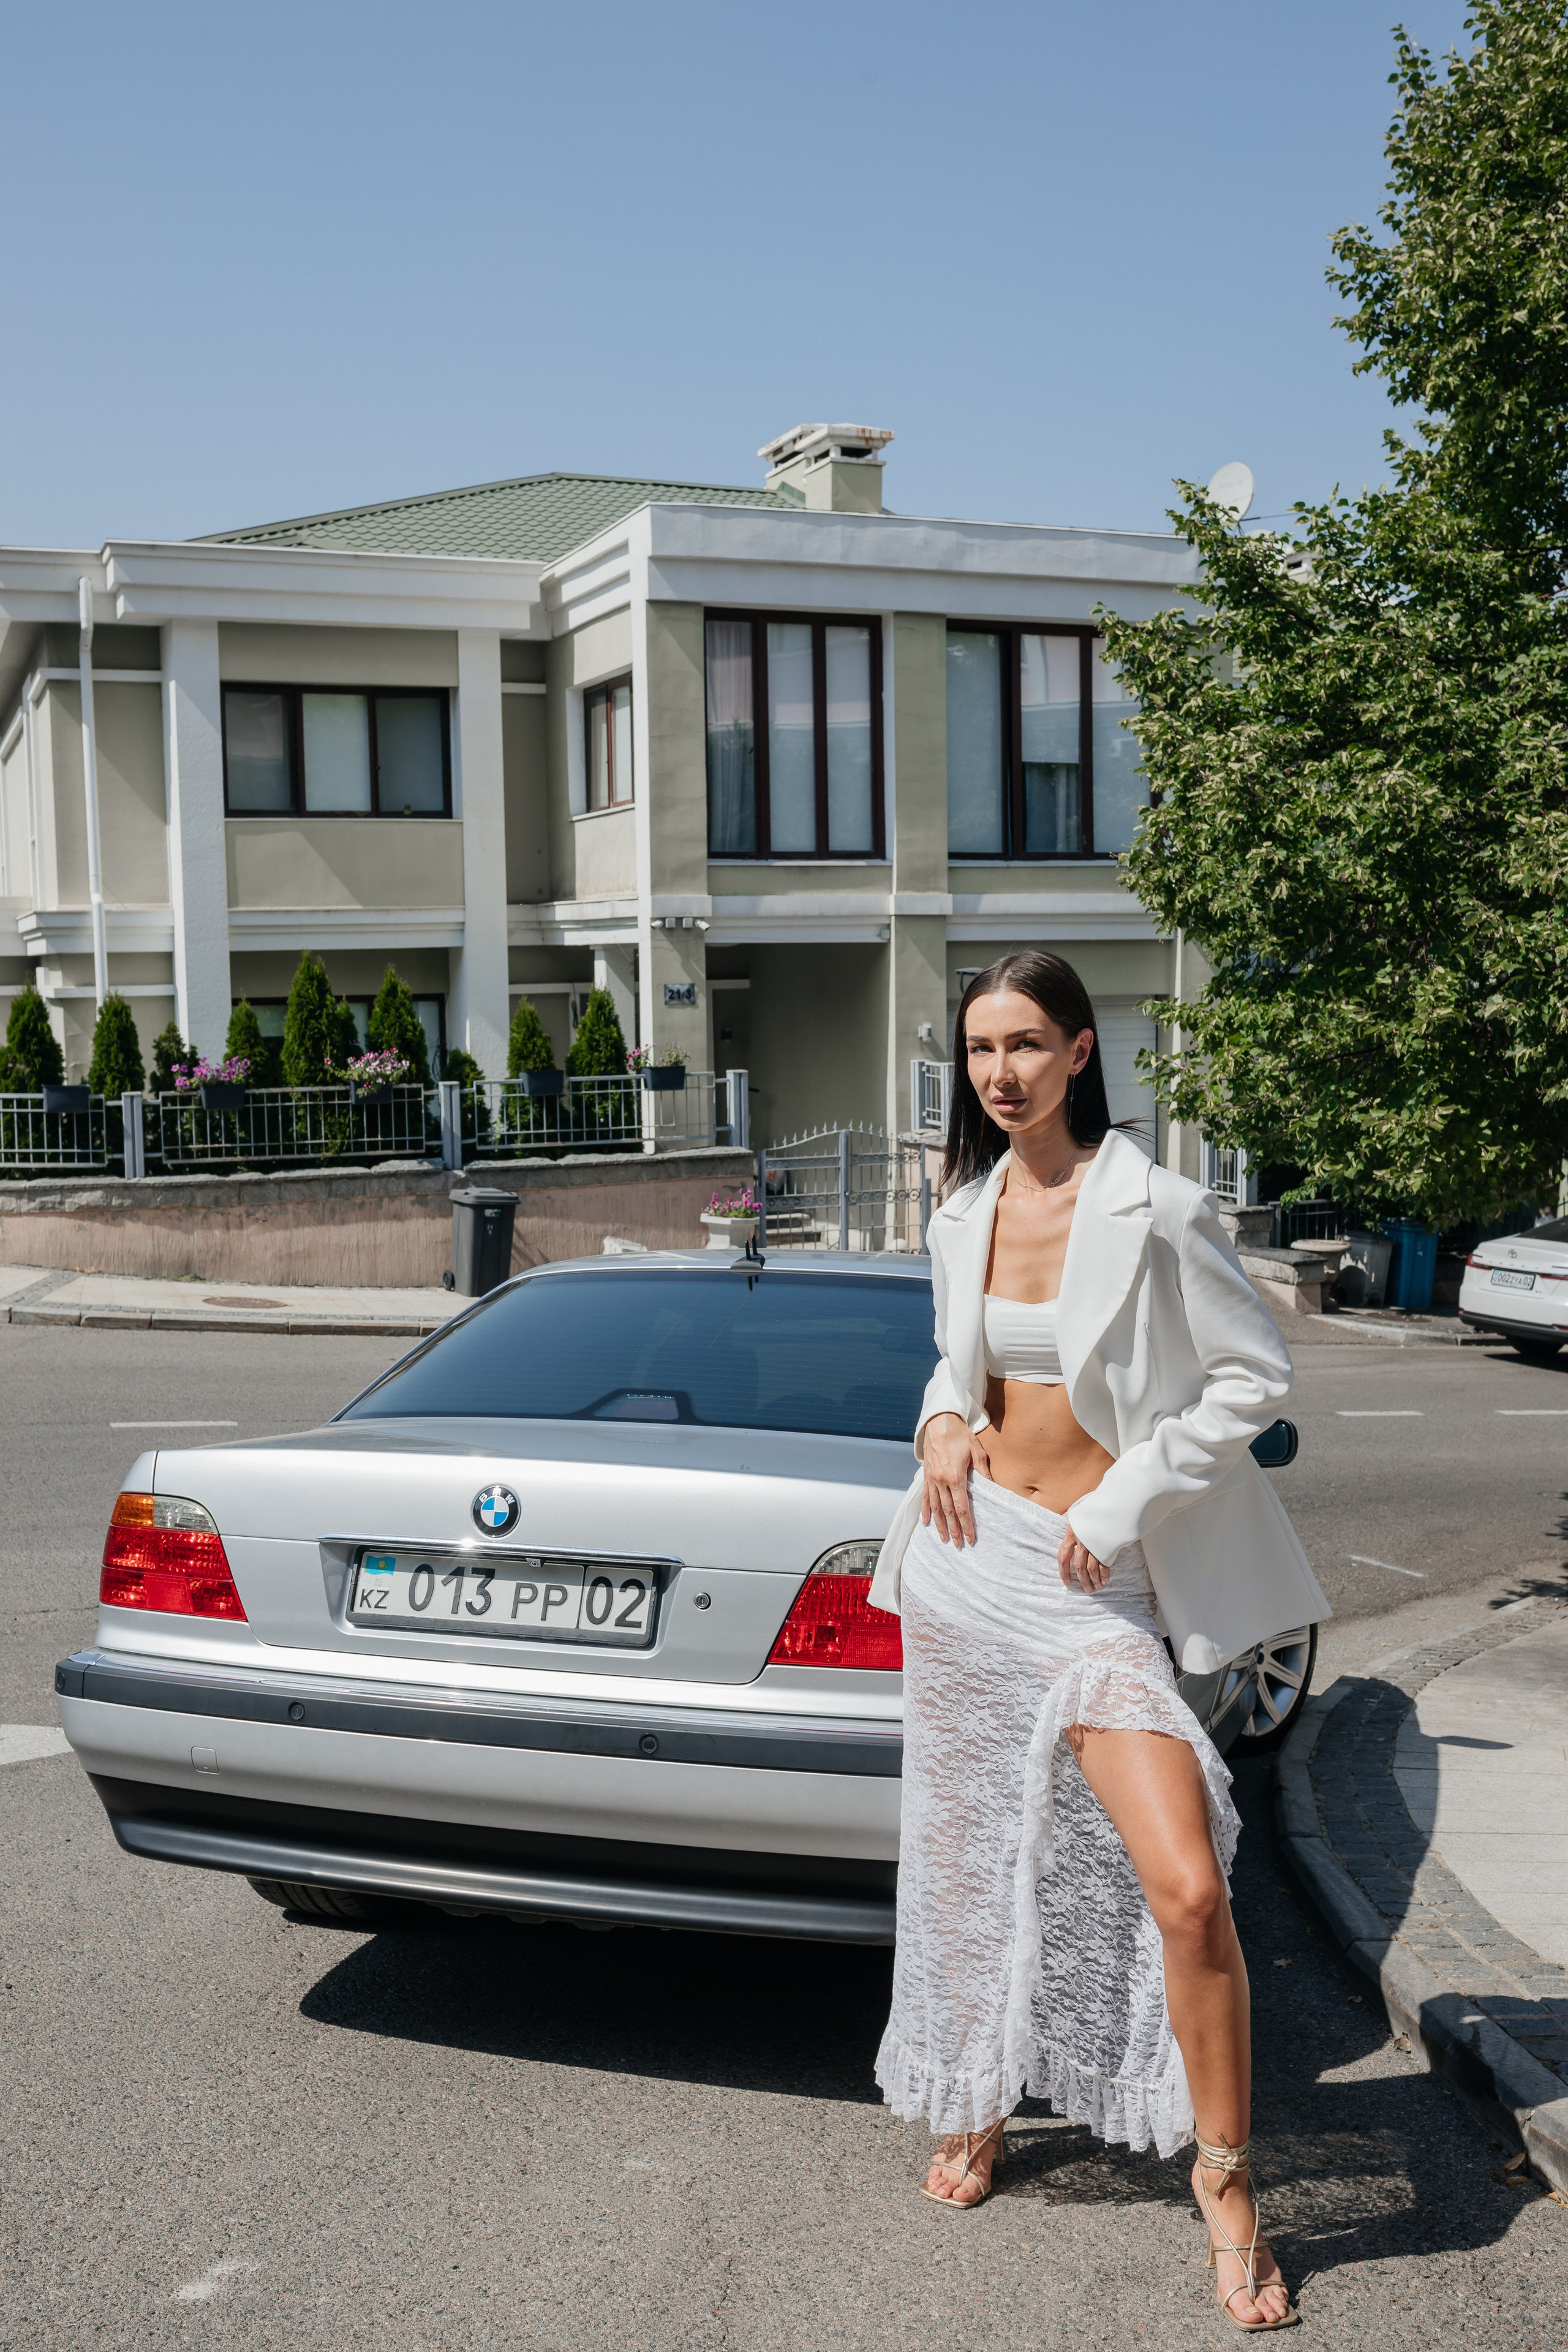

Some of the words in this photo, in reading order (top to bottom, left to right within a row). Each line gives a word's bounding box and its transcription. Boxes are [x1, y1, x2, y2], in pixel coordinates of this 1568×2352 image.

[668, 989, 692, 1000] 21/3
[1523, 1276, 1533, 1286] 02
[478, 1487, 516, 1504] BMW
[360, 1588, 390, 1609] KZ
[409, 1564, 496, 1615] 013
[511, 1582, 568, 1621] PP
[586, 1576, 646, 1628] 02
